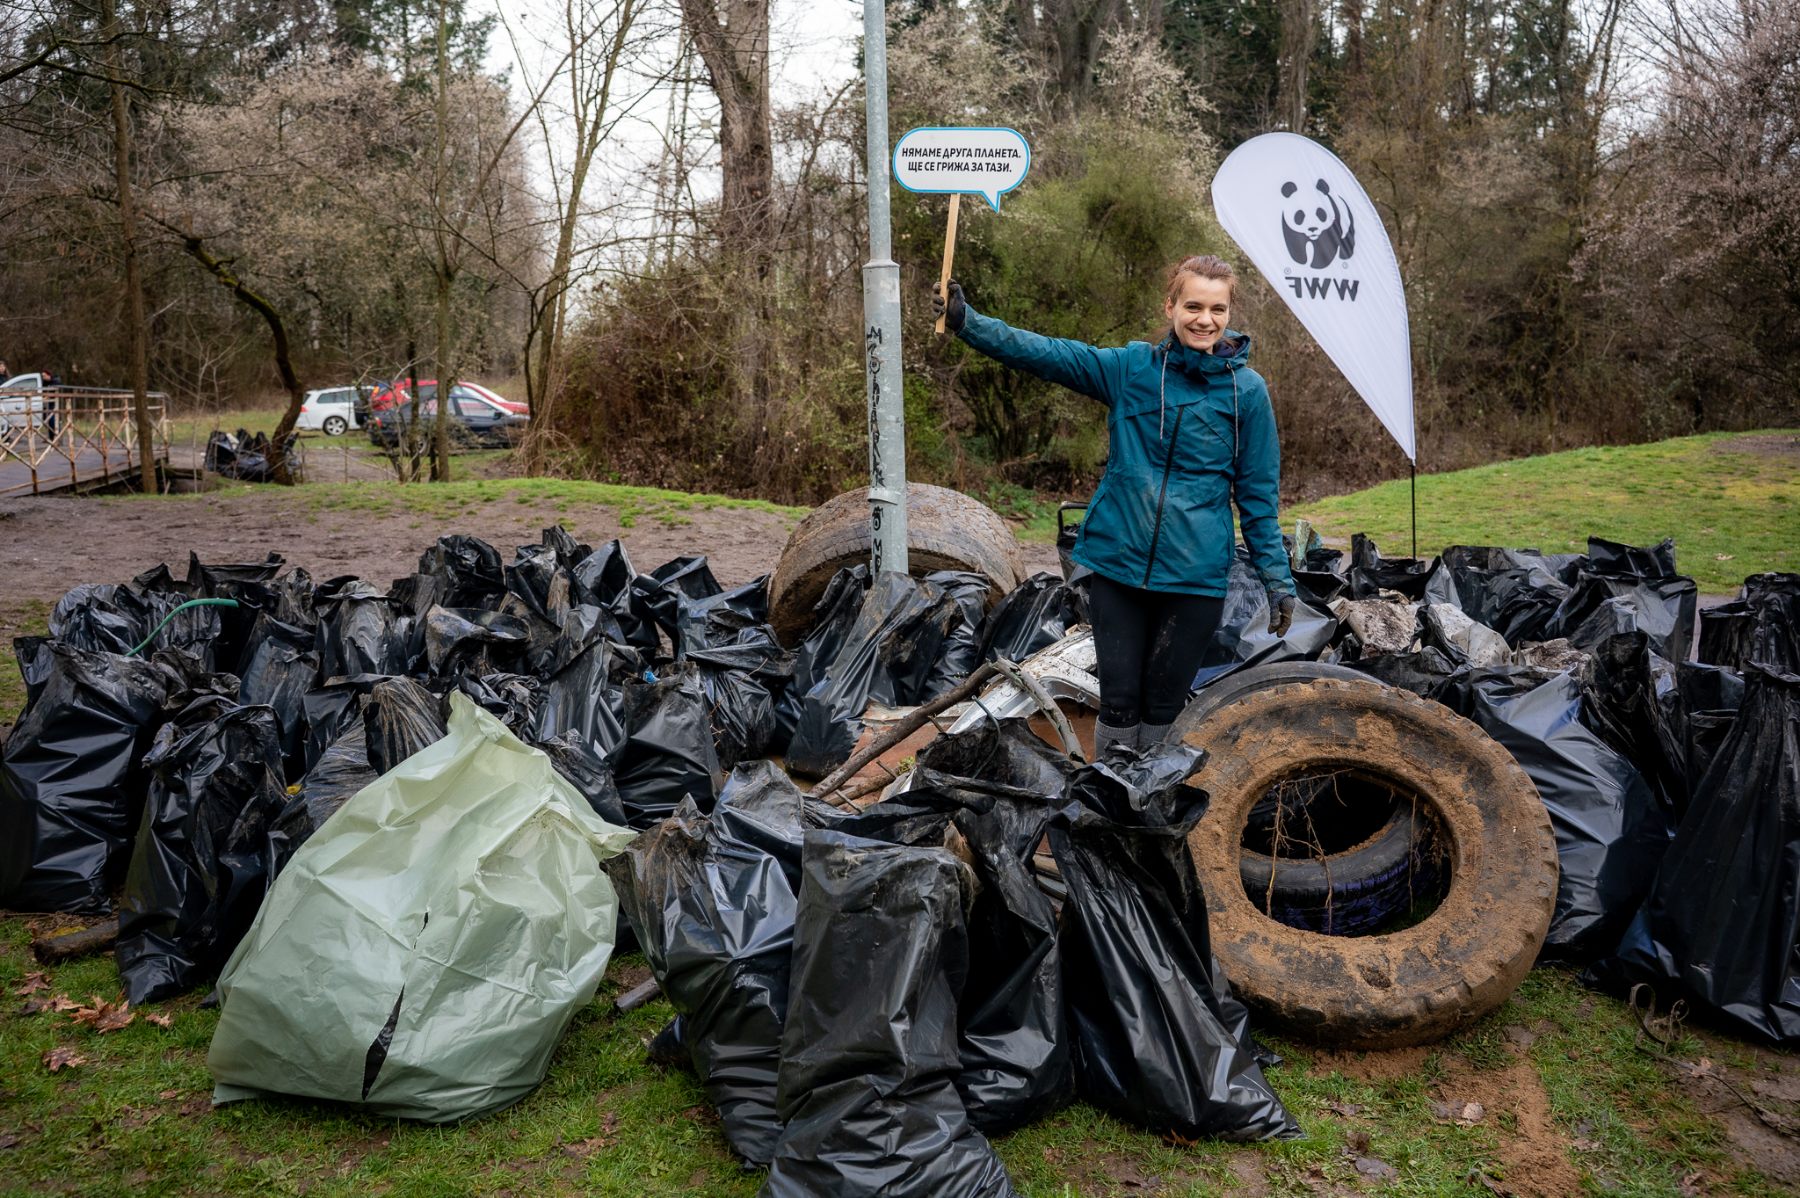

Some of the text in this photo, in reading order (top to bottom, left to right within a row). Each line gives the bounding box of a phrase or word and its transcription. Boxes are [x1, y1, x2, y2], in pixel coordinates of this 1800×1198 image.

[902, 147, 1022, 159] НЯМАМЕ ДРУГА ПЛАНЕТА.
[908, 161, 1012, 173] ЩЕ СЕ ГРИЖА ЗА ТАЗИ.
